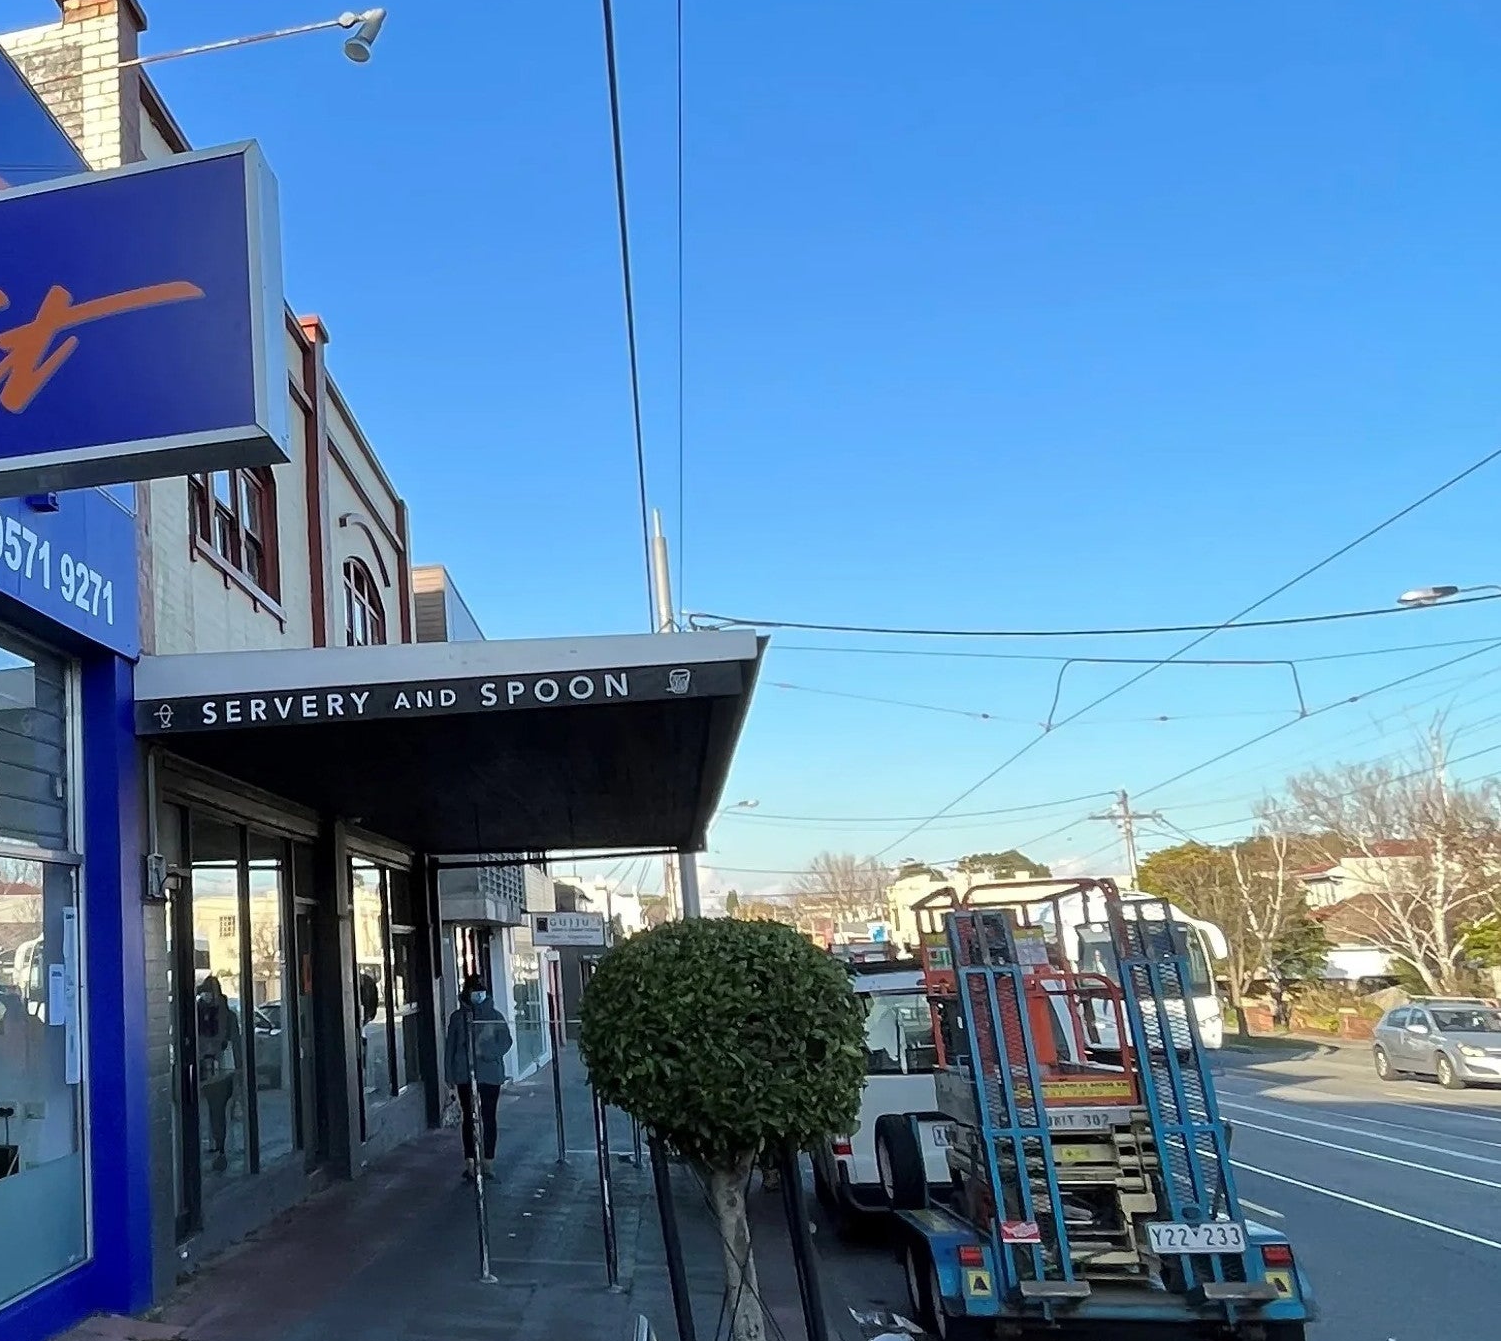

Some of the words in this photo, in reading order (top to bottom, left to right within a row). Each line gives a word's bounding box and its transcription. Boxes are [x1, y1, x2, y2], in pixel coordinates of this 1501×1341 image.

[60, 553, 114, 626] 9271
[202, 692, 370, 725] SERVERY
[394, 689, 456, 710] AND
[480, 673, 629, 707] SPOON
